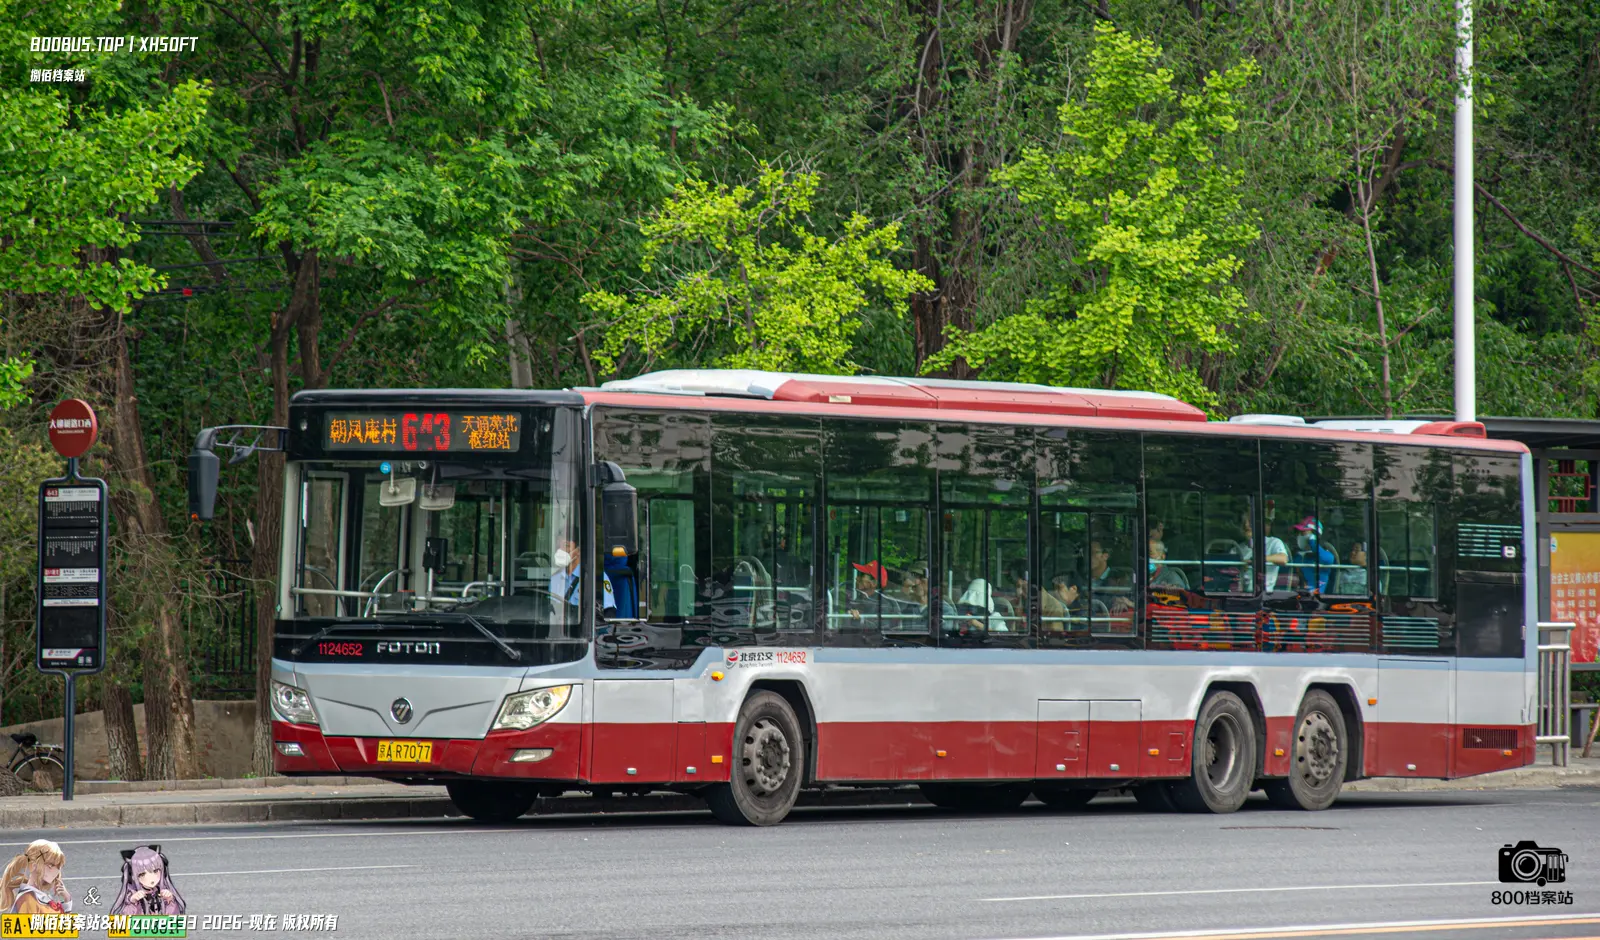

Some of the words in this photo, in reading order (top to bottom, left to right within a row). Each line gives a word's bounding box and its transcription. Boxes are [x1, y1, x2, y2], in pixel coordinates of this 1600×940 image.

[330, 418, 397, 444] 朝凤庵村
[401, 413, 451, 451] 643
[462, 415, 518, 432] 天通苑北
[468, 432, 511, 450] 枢纽站
[318, 643, 362, 656] 1124652
[376, 642, 439, 654] FOTON
[740, 652, 773, 661] 北京公交
[776, 651, 806, 664] 1124652
